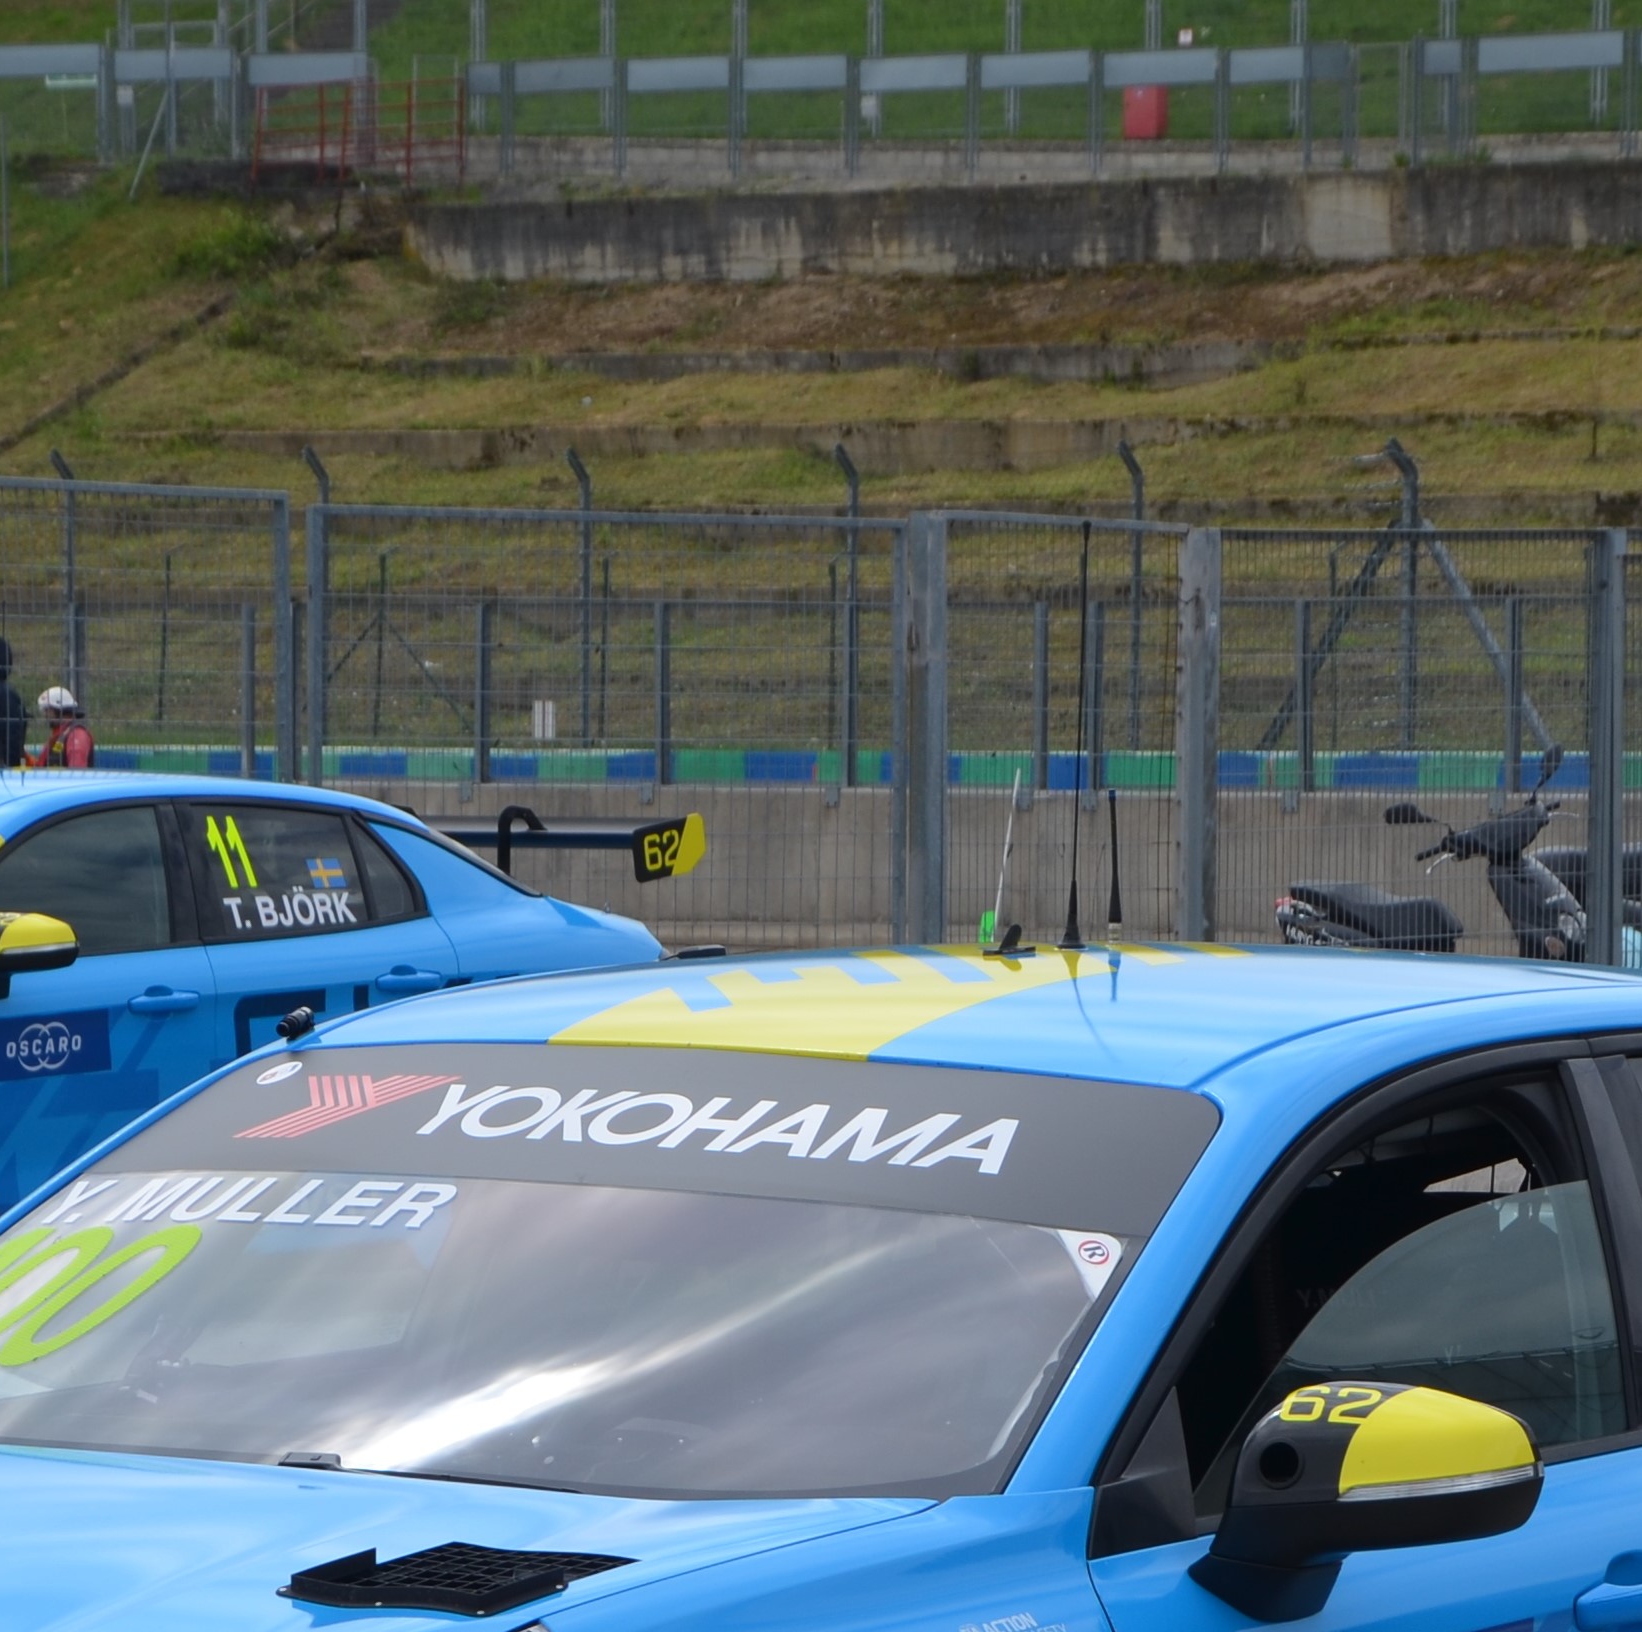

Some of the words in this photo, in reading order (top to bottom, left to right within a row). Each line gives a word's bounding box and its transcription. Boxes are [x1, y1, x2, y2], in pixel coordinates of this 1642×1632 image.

[205, 815, 258, 890] 11
[643, 829, 681, 873] 62
[222, 896, 252, 931] T.
[255, 885, 358, 928] BJÖRK
[6, 1034, 83, 1059] OSCARO
[417, 1084, 1020, 1175] YOKOHAMA
[40, 1178, 119, 1225] Y.
[123, 1177, 460, 1229] MULLER
[1278, 1384, 1384, 1425] 62
